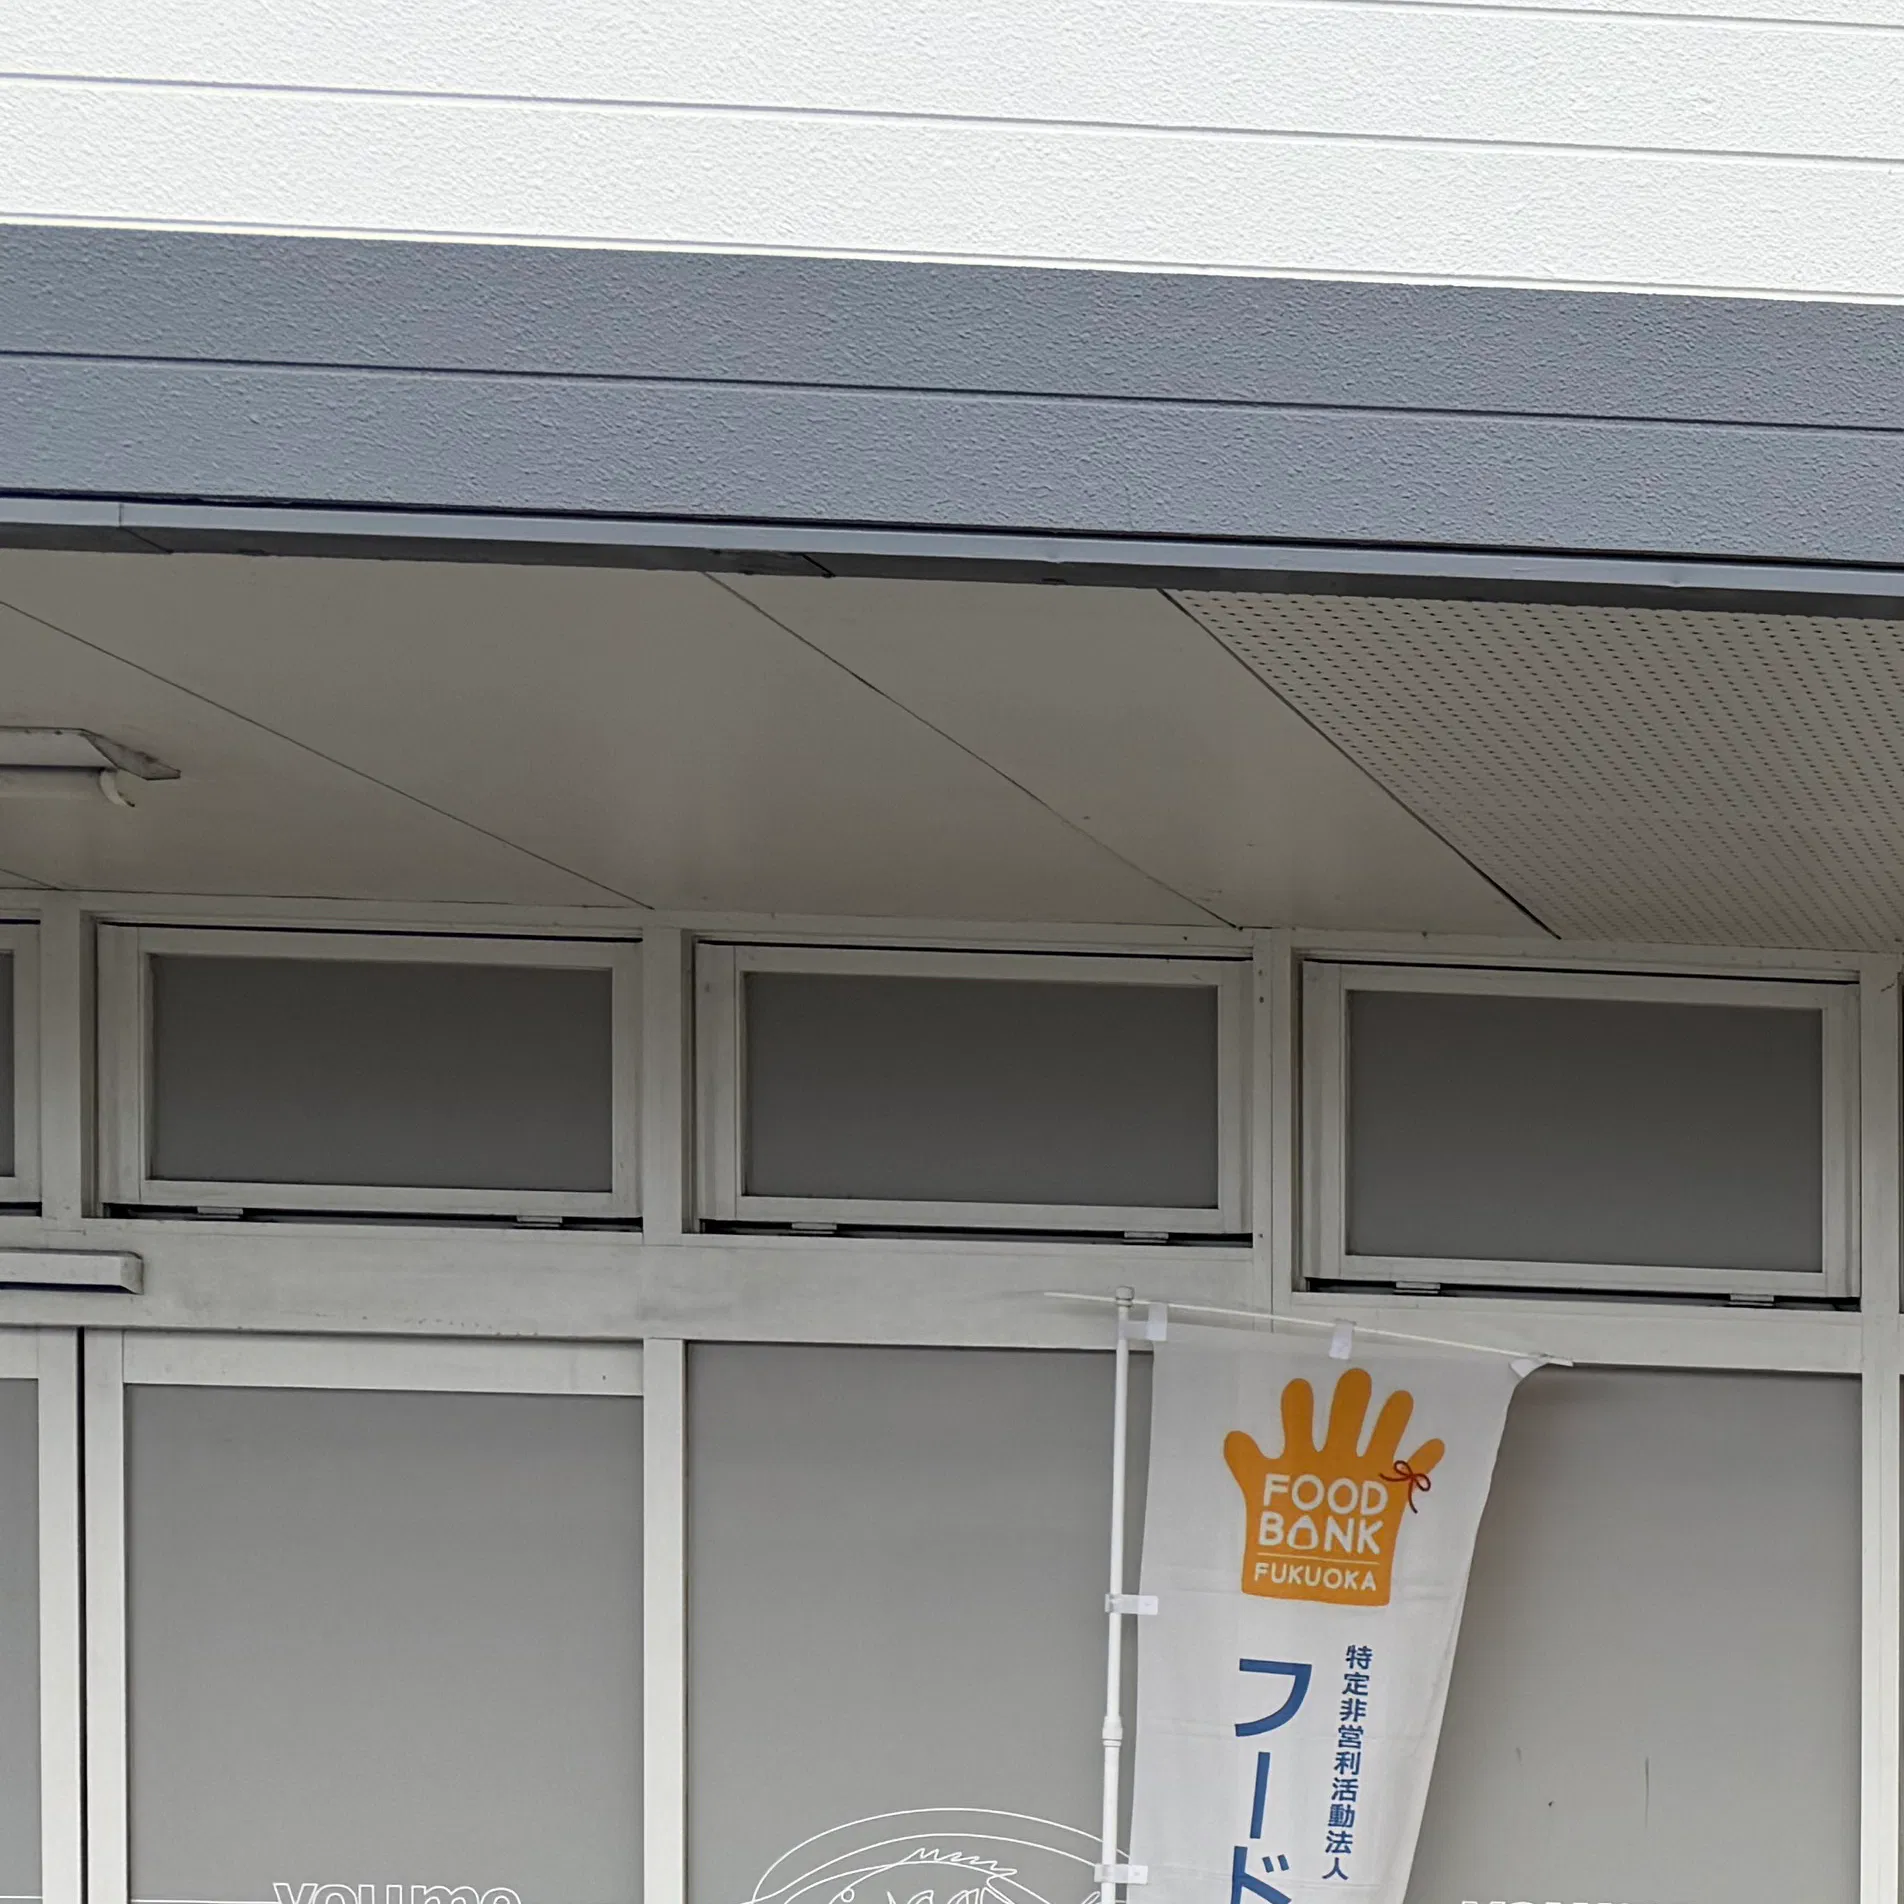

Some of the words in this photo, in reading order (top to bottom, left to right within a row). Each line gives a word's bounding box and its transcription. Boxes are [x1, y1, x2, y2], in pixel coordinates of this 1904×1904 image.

[1263, 1473, 1389, 1516] FOOD
[1258, 1511, 1384, 1555] BANK
[1254, 1562, 1377, 1592] FUKUOKA
[1322, 1644, 1373, 1881] 特定非営利活動法人
